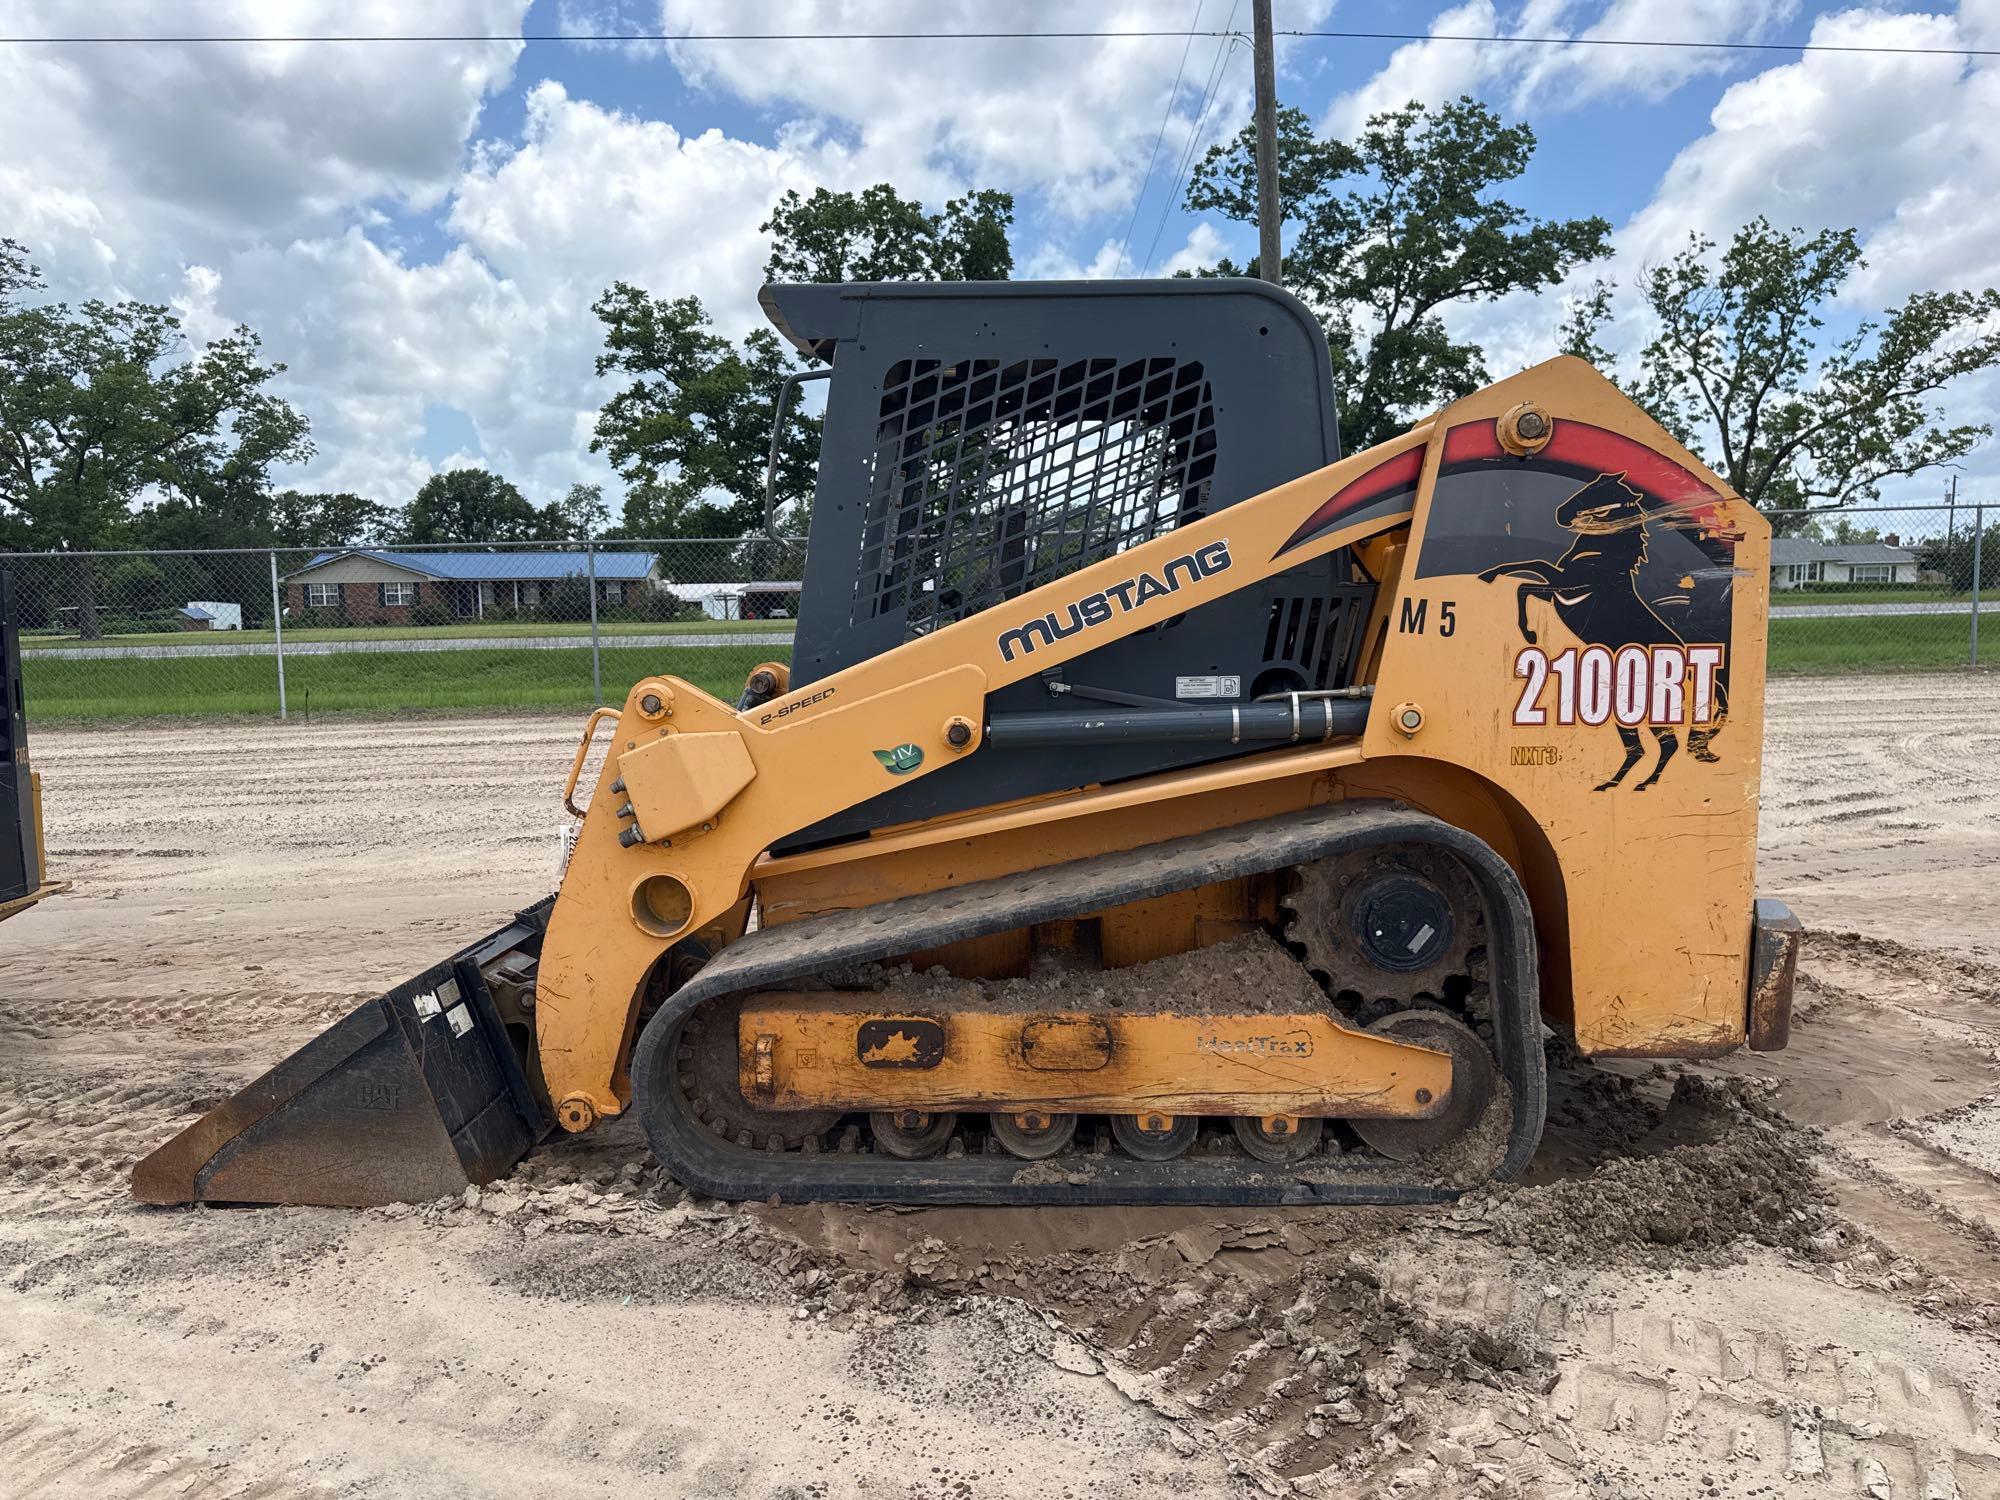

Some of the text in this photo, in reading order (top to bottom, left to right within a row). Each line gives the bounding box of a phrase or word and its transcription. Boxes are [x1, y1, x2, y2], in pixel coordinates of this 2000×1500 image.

[997, 539, 1234, 663] MUSTANG
[1399, 596, 1457, 638] M 5
[760, 687, 837, 726] 2-SPEED
[1512, 644, 1725, 728] 2100RT
[1510, 745, 1558, 766] NXT3
